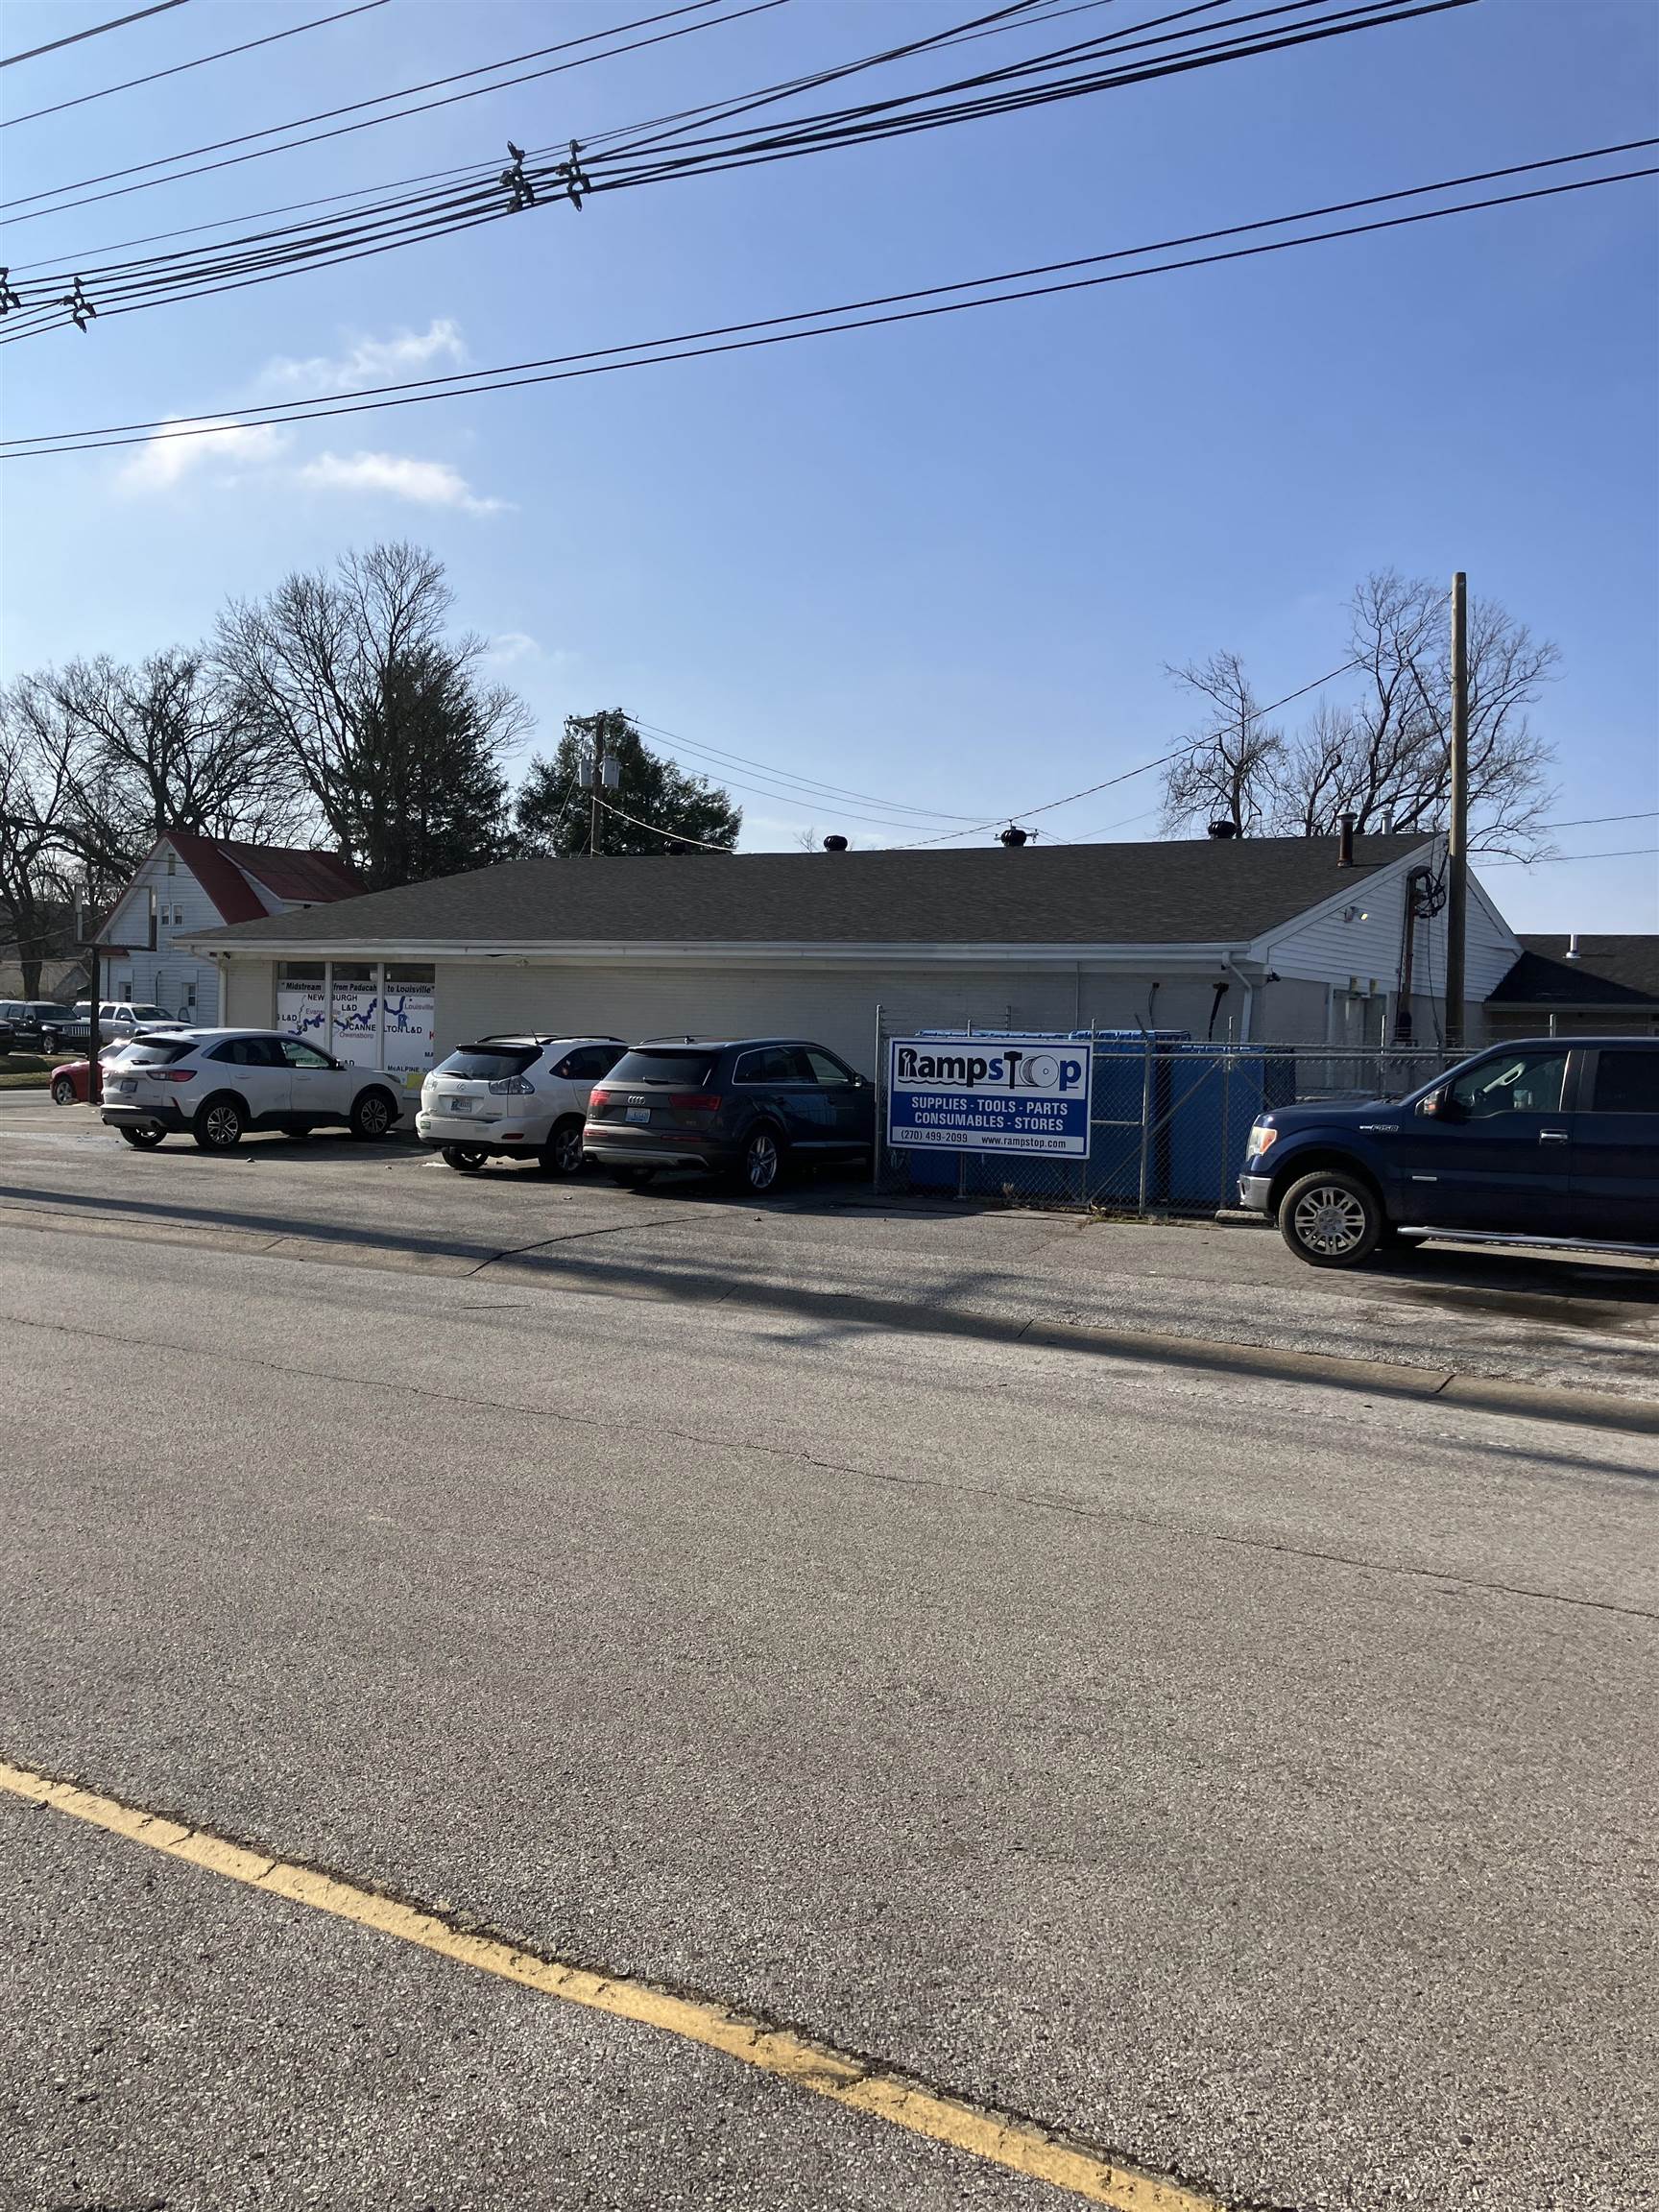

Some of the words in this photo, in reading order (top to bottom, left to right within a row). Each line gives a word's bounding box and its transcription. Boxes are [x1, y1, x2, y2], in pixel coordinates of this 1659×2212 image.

[912, 1096, 967, 1110] SUPPLIES
[977, 1099, 1016, 1113] TOOLS
[1026, 1102, 1068, 1116] PARTS
[914, 1112, 1003, 1128] CONSUMABLES
[1014, 1118, 1064, 1131] STORES
[901, 1129, 923, 1141] (270)
[926, 1131, 968, 1142] 499-2099
[981, 1136, 1066, 1148] www.rampstop.com
